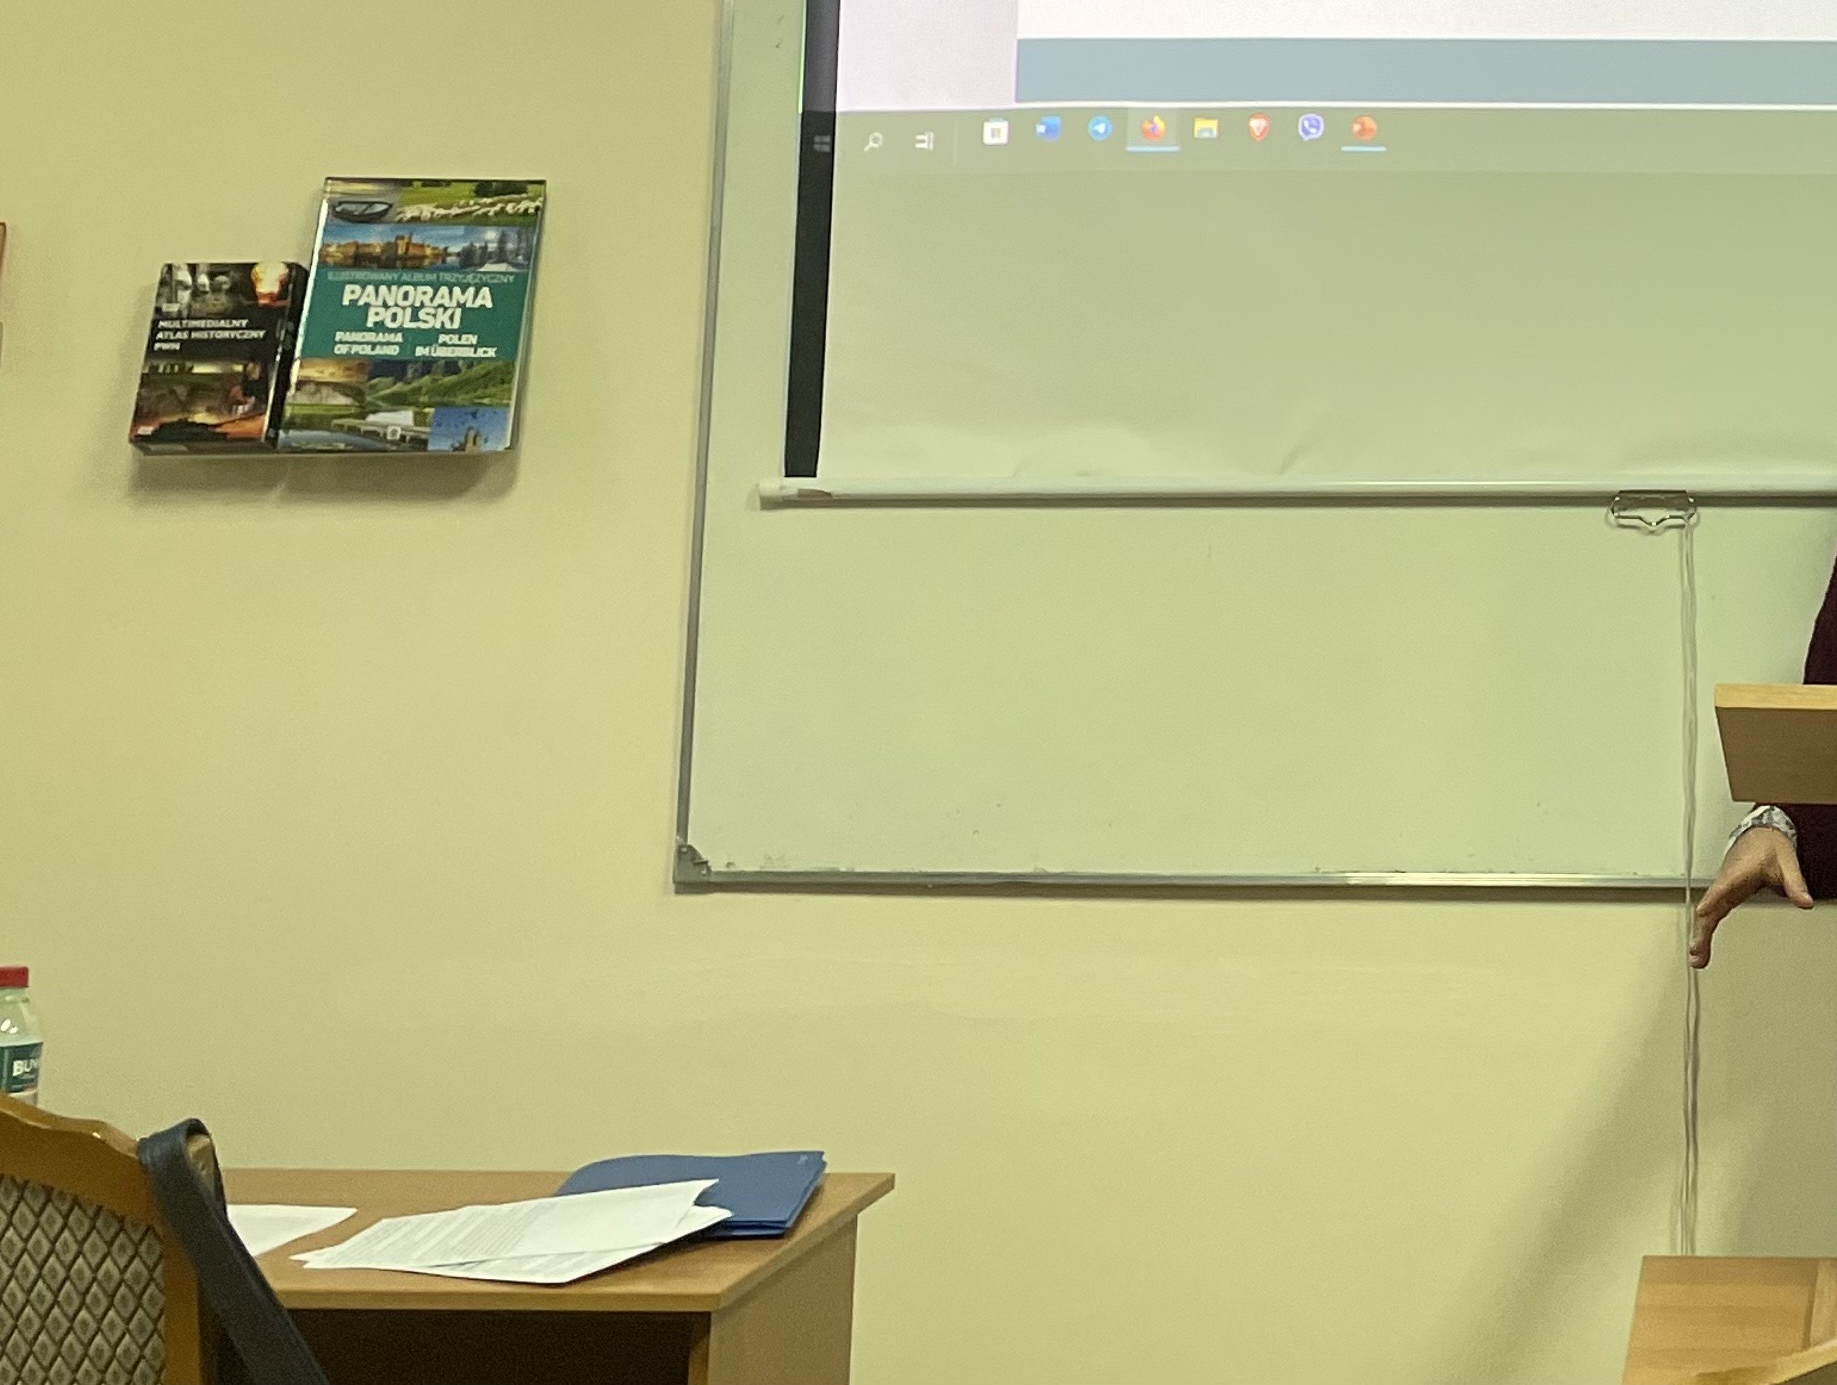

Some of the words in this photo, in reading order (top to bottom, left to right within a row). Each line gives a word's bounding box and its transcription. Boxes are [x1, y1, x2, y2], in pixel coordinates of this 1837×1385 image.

[342, 283, 493, 308] PANORAMA
[158, 318, 250, 329] MULTIMEDIALNY
[366, 306, 463, 330] POLSKI
[155, 330, 189, 341] ATLAS
[191, 329, 267, 341] HISTORYCZNY
[335, 331, 403, 344] PANORAMA
[438, 333, 478, 345] POLEN
[351, 344, 400, 357] POLAND
